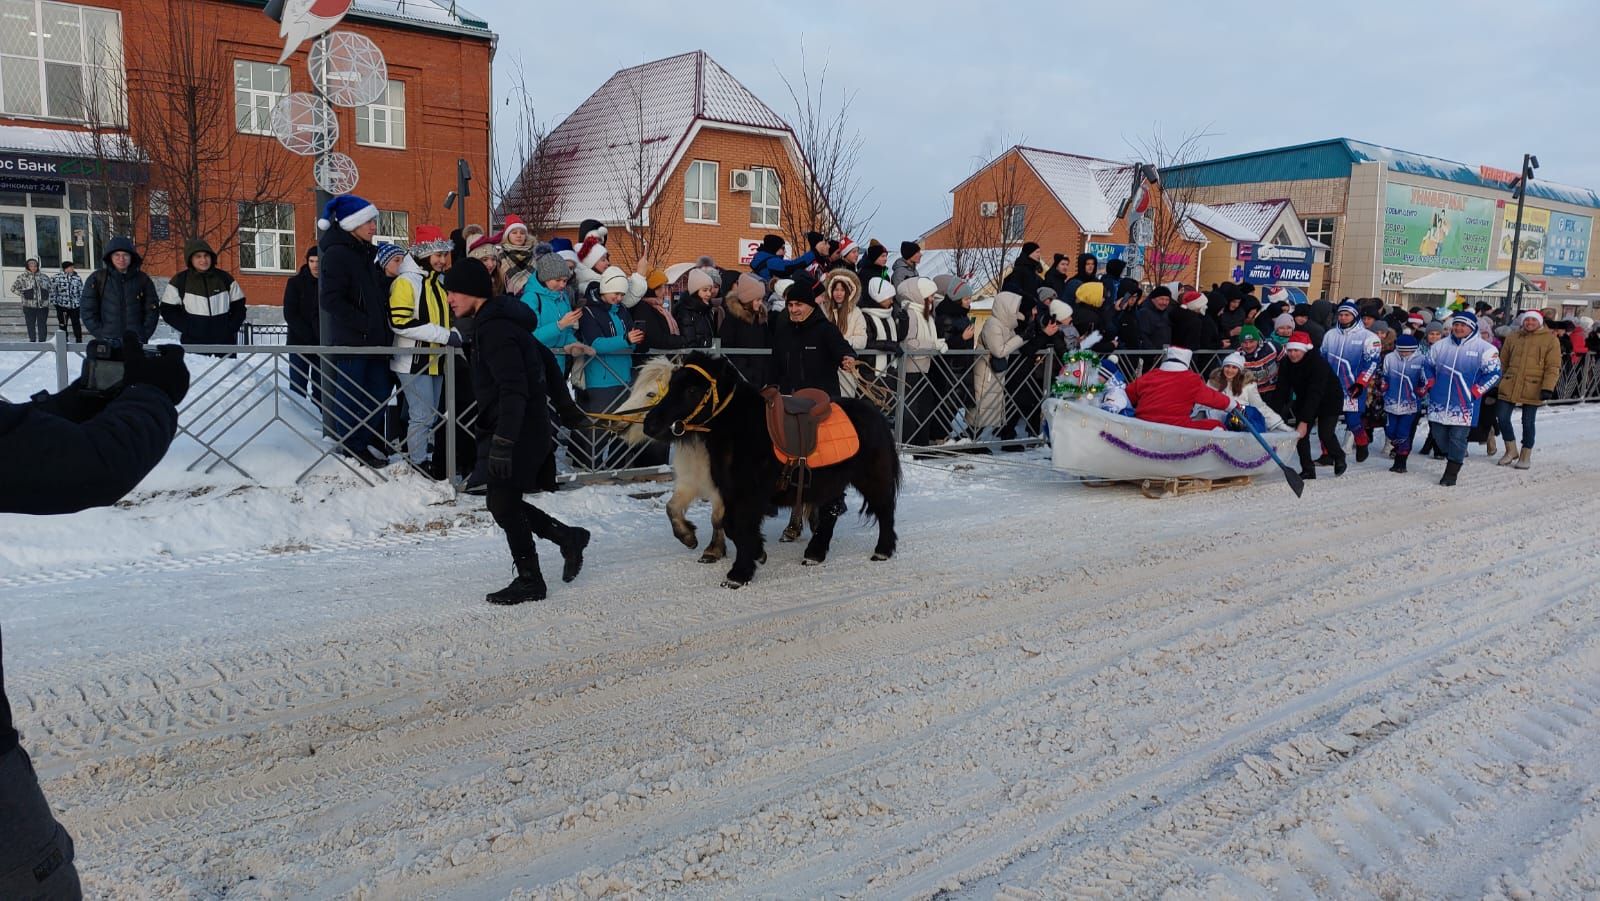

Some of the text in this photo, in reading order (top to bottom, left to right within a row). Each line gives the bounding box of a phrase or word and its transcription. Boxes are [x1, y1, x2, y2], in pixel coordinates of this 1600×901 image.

[18, 158, 57, 173] Банк
[40, 183, 60, 192] 24/7
[1249, 270, 1271, 278] АПТЕКА
[1280, 268, 1310, 280] АПРЕЛЬ
